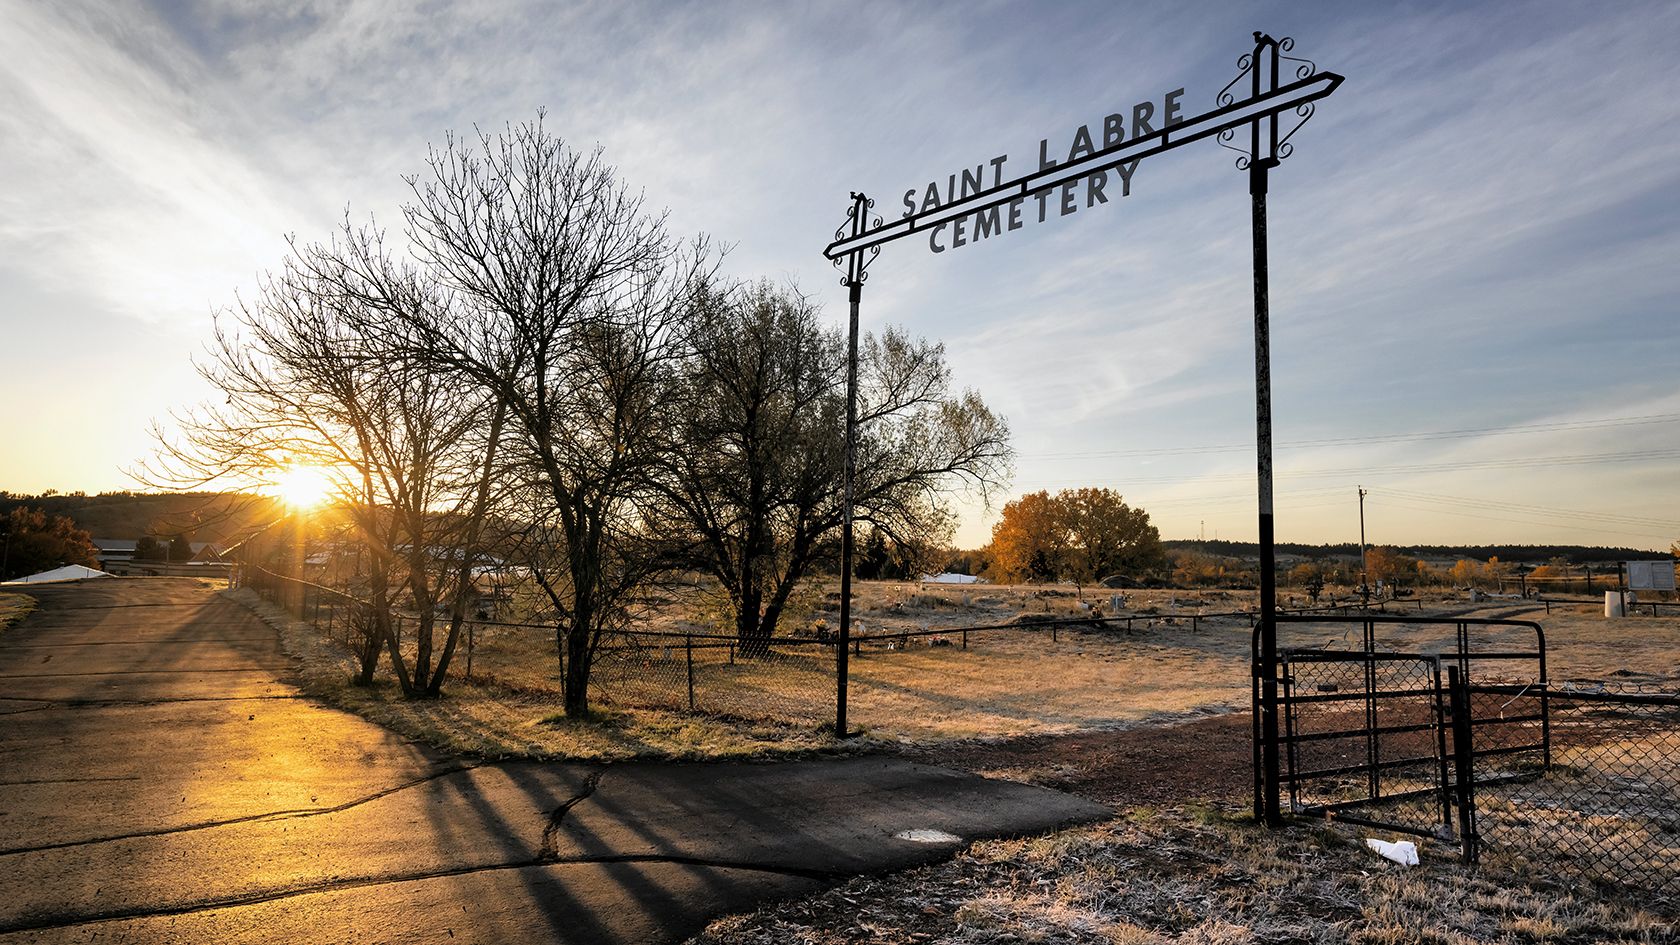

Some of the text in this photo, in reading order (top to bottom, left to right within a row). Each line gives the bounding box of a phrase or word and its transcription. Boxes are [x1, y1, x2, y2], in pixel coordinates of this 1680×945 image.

[903, 87, 1184, 219] SAINT LABRE
[929, 157, 1142, 253] CEMETERY
